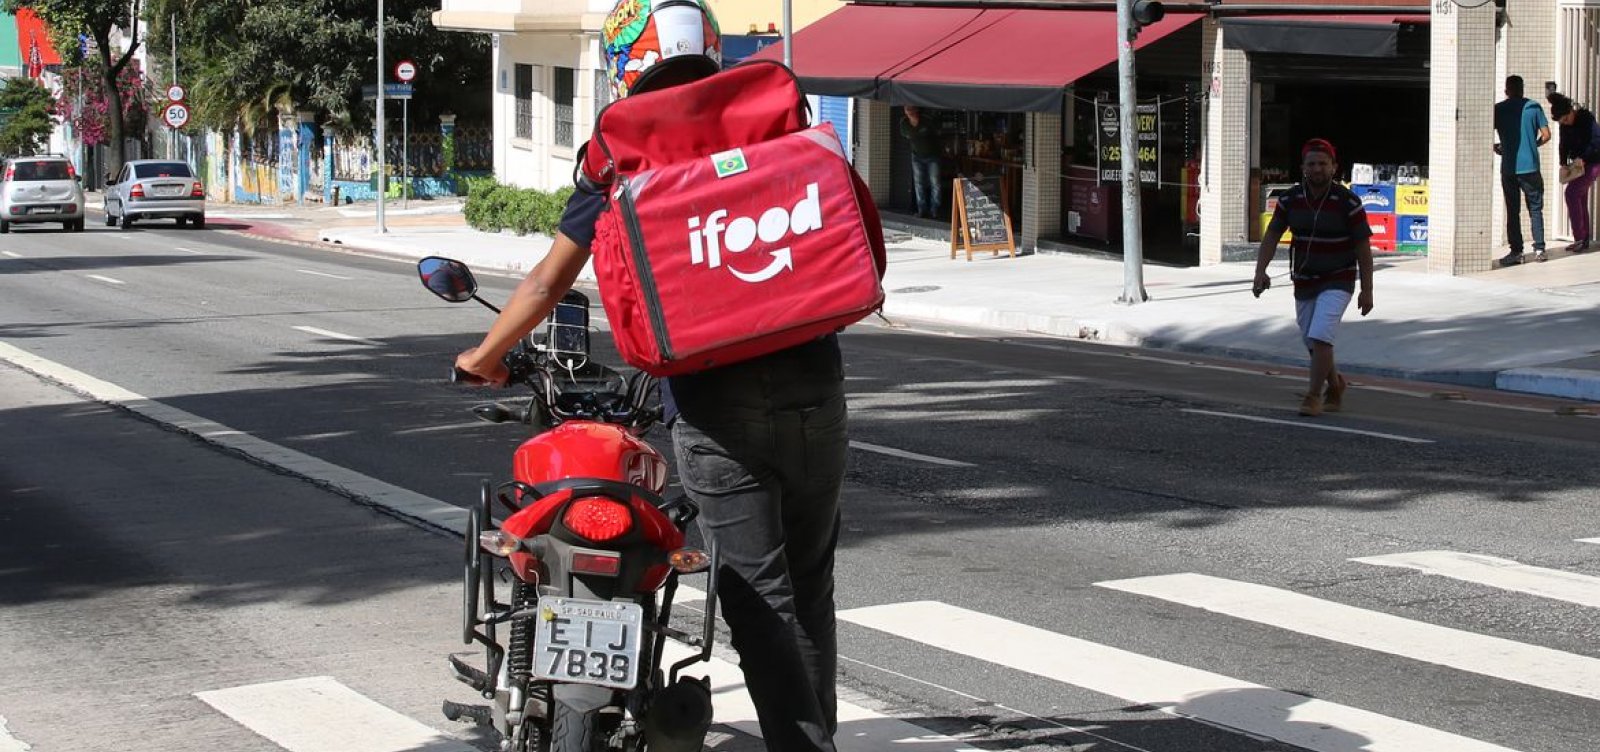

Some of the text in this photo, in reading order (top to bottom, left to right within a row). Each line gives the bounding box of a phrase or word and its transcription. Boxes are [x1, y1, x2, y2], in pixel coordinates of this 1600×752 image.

[1436, 0, 1452, 15] 1131
[169, 108, 185, 119] 50
[1404, 195, 1428, 205] SKO
[688, 182, 822, 269] ifood
[551, 616, 627, 650] EIJ
[547, 646, 630, 681] 7839
